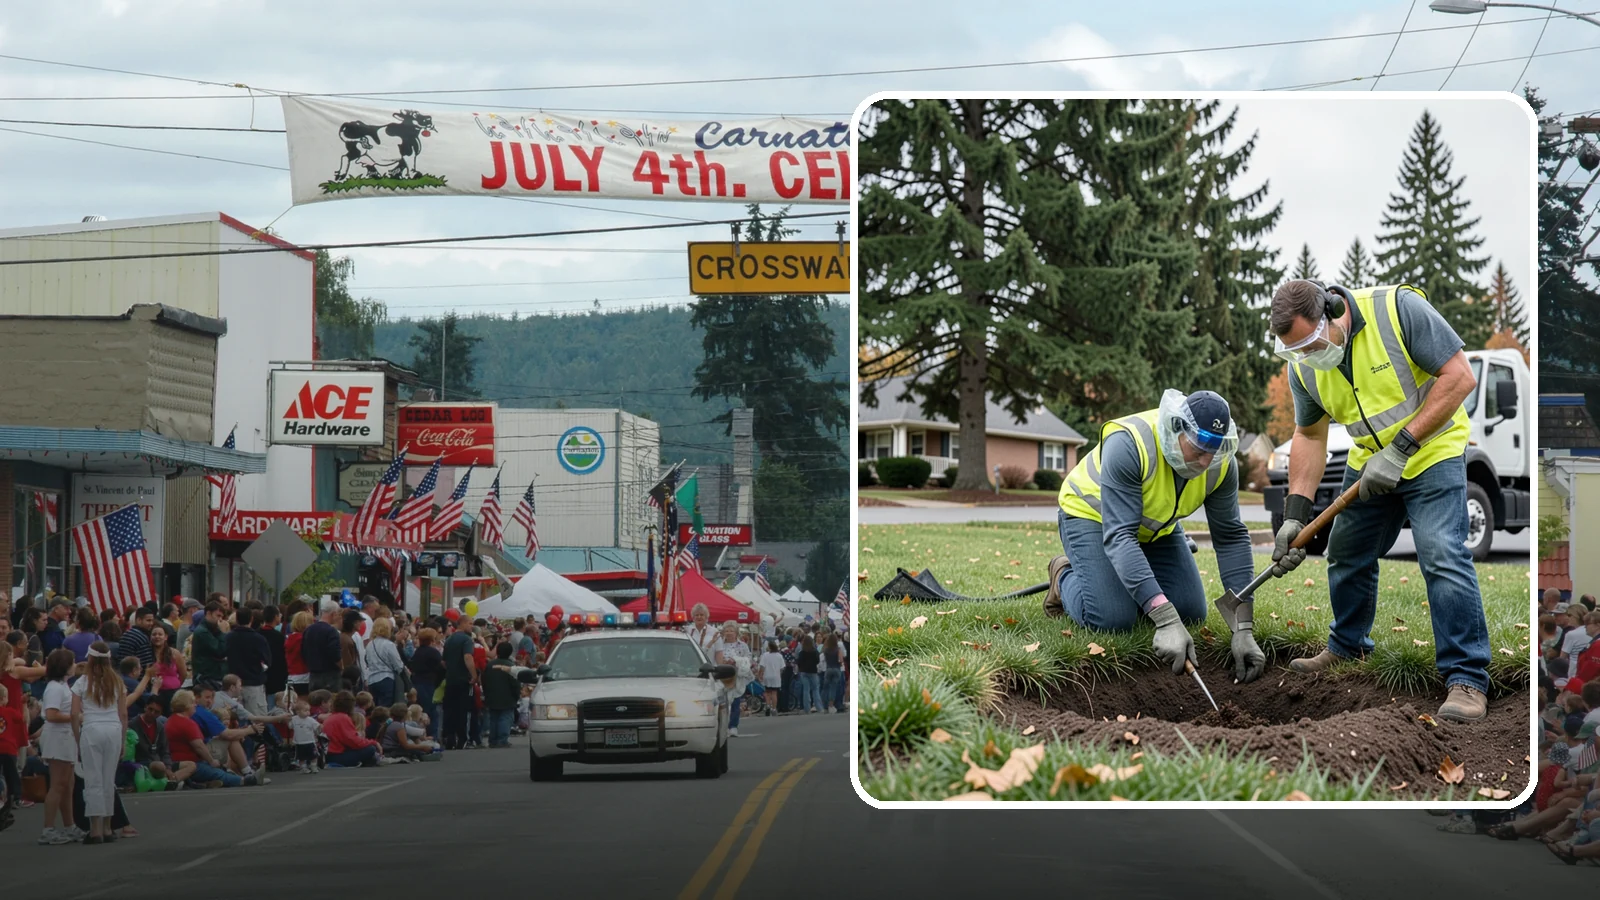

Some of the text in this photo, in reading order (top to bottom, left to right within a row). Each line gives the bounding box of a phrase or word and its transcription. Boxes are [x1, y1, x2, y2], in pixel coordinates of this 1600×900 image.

[695, 121, 850, 150] Carnat
[481, 141, 605, 192] JULY
[632, 150, 746, 197] 4th.
[697, 254, 850, 280] CROSSWA
[282, 380, 374, 420] ACE
[406, 409, 453, 422] CEDAR
[283, 421, 371, 436] Hardware
[416, 423, 477, 447] Coca-Cola
[353, 467, 386, 480] Simpl
[83, 485, 155, 495] St. Vincent de Paul
[213, 516, 330, 535] HARDARE
[688, 526, 741, 535] CRNATION
[699, 535, 730, 543] GLASS
